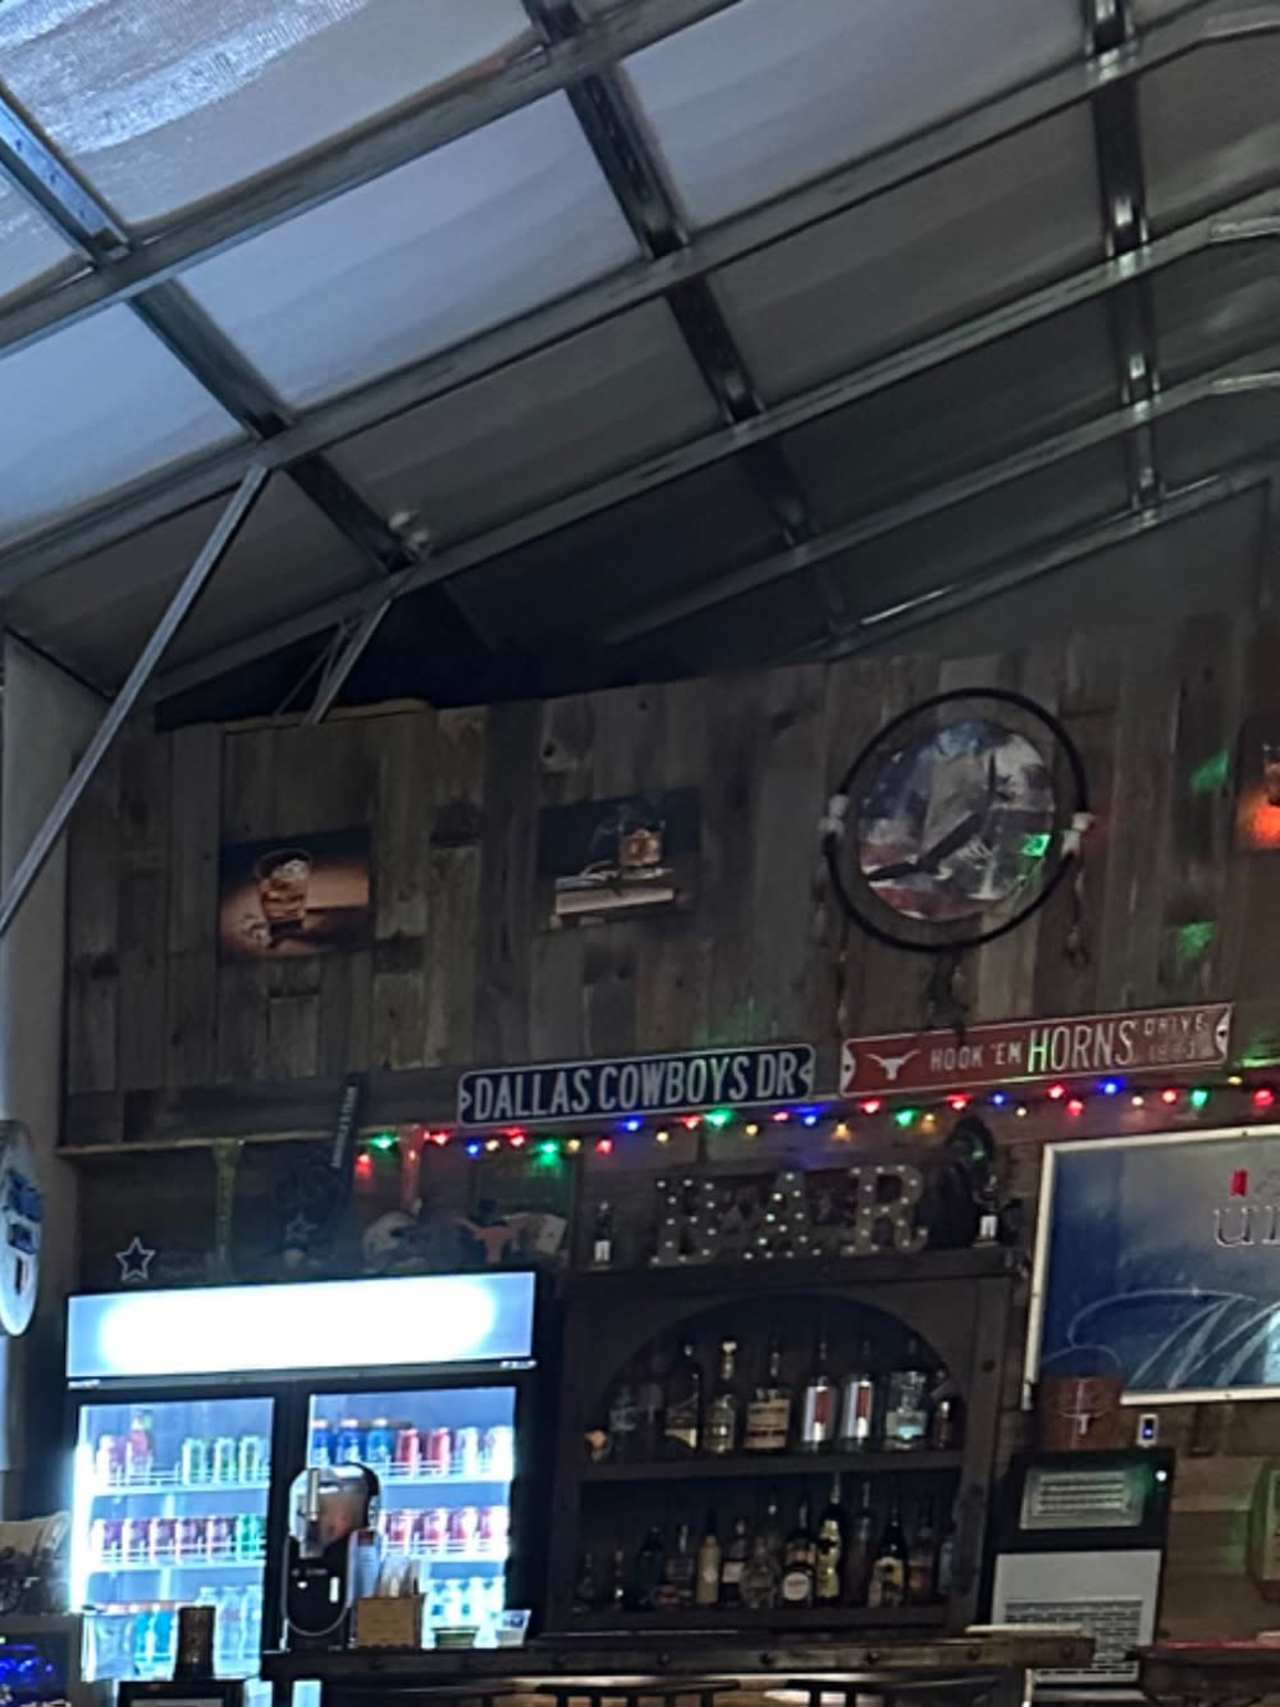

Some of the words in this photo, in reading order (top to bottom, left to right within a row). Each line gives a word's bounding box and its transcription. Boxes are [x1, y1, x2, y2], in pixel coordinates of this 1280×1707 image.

[929, 1045, 984, 1073] HOOK
[1027, 1018, 1138, 1073] HORNS
[473, 1068, 590, 1121] DALLAS
[598, 1055, 750, 1110] COWBOYS
[756, 1051, 798, 1099] DR
[648, 1163, 928, 1268] BAR
